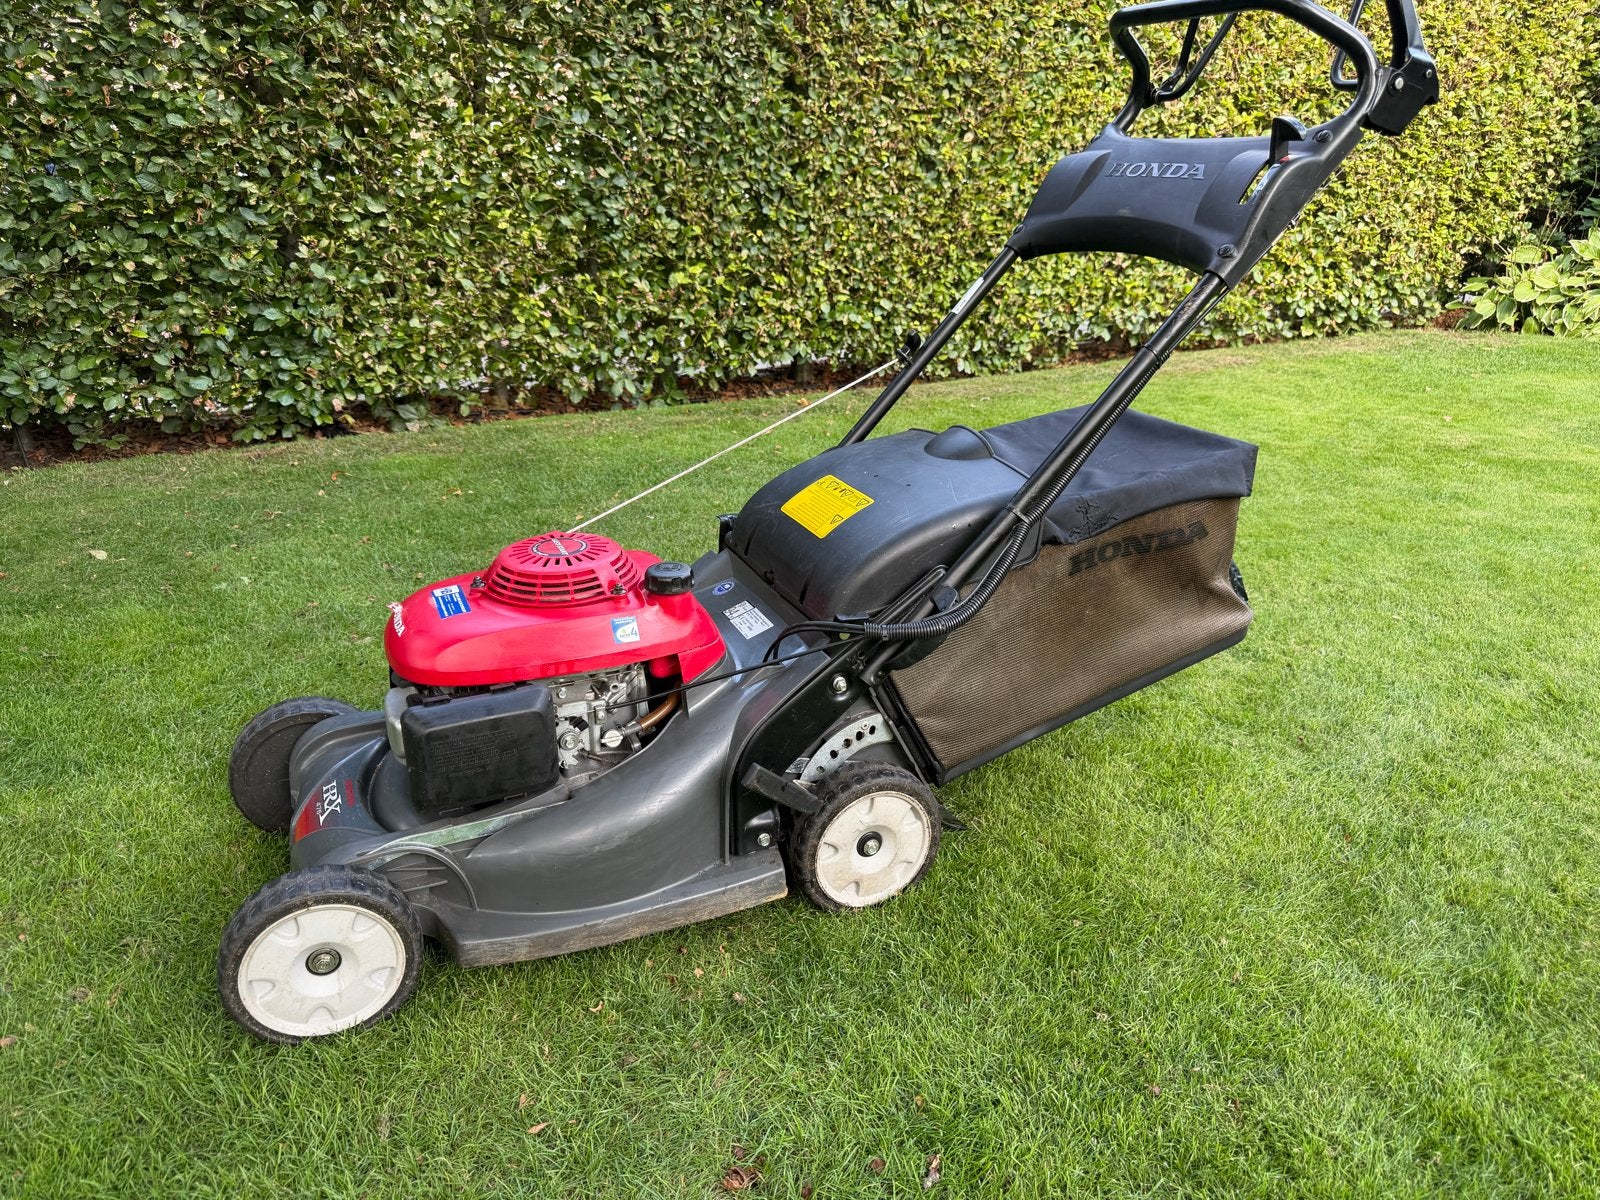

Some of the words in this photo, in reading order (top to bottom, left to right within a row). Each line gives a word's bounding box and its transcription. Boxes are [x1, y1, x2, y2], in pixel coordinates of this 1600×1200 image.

[1104, 161, 1205, 180] HONDA
[1068, 520, 1208, 576] HONDA
[319, 780, 342, 826] HRX
